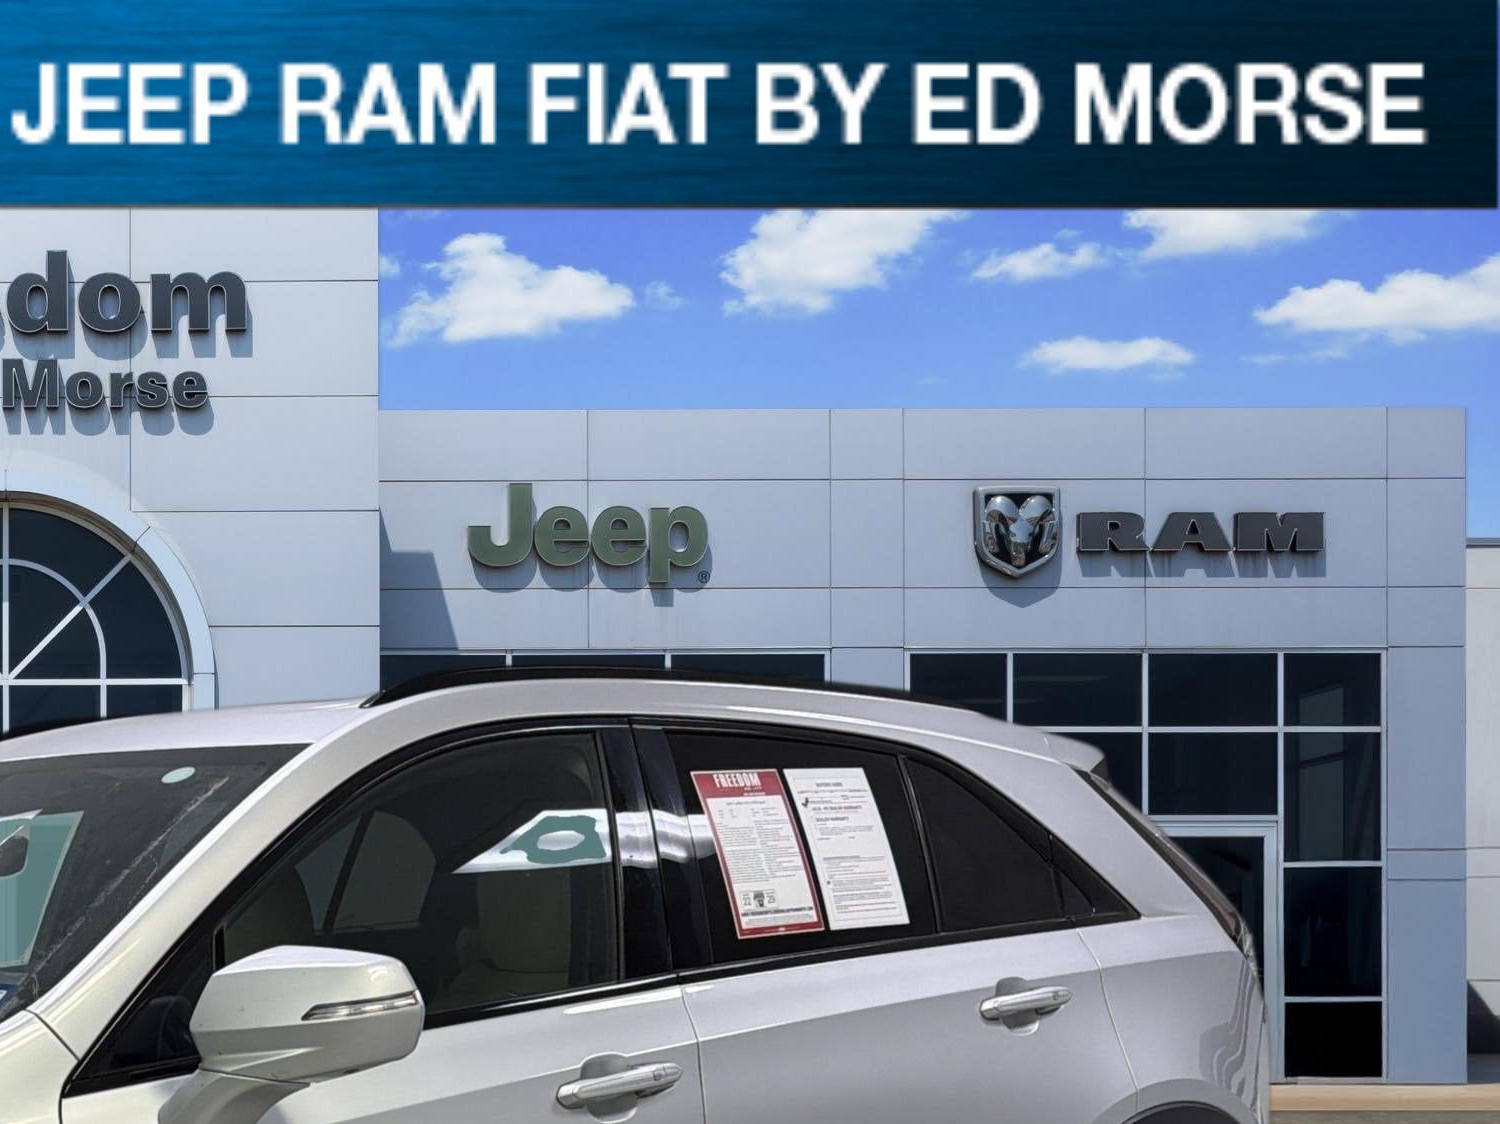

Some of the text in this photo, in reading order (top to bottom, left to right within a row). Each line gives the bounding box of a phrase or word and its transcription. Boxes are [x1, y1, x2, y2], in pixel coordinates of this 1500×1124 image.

[1, 358, 209, 409] Morse
[467, 482, 709, 583] Jeep
[1076, 511, 1326, 553] RAM
[712, 773, 762, 788] FREEDOM
